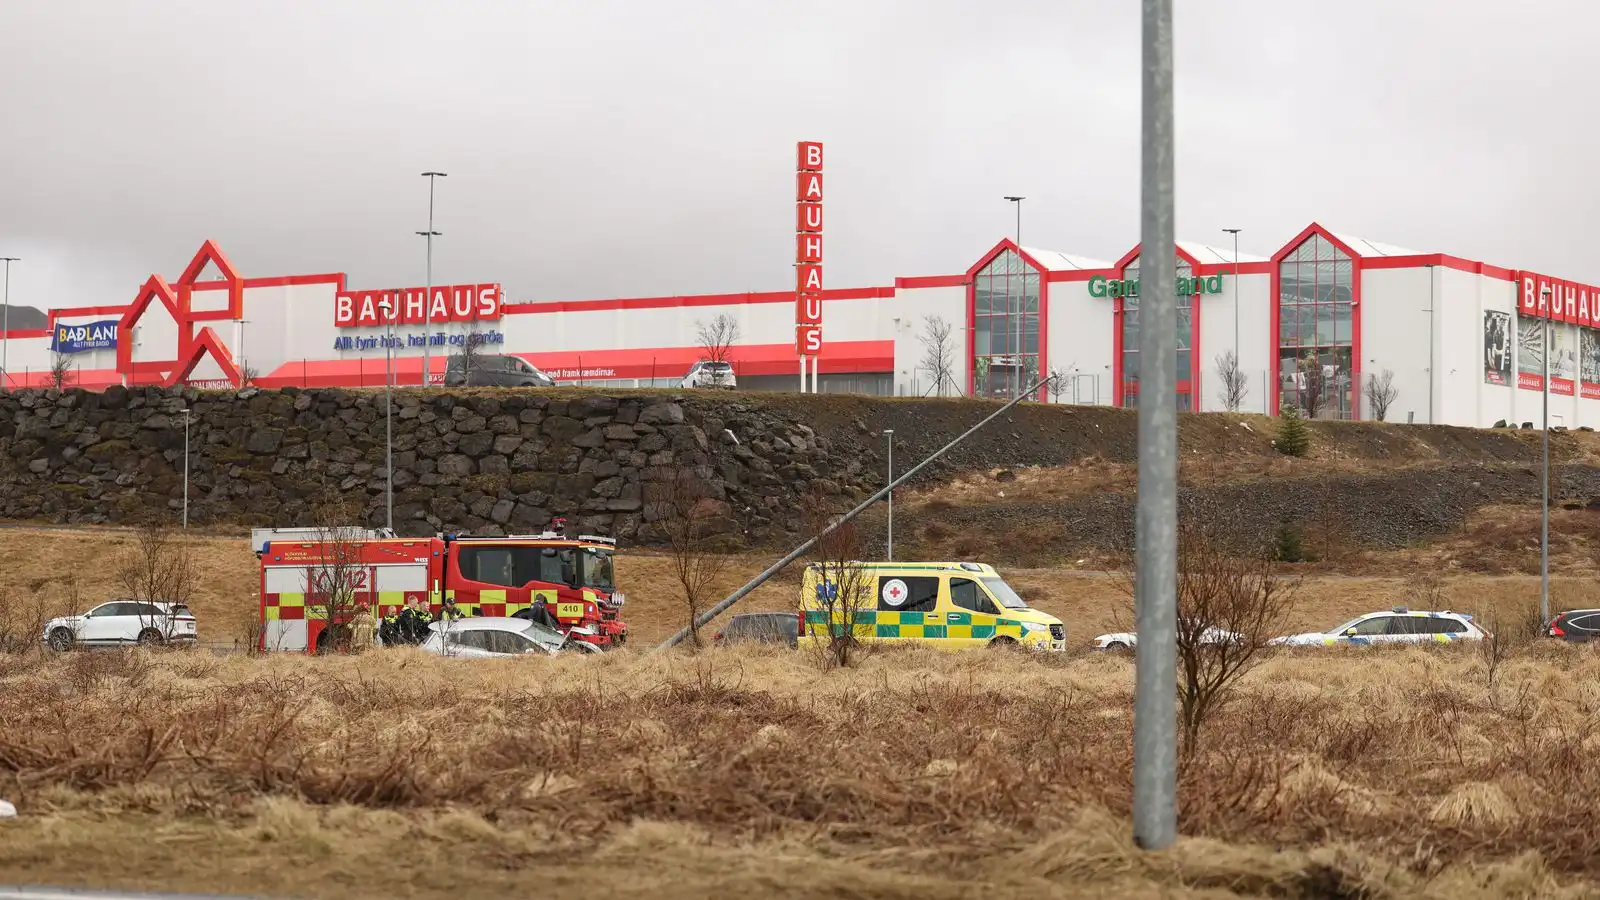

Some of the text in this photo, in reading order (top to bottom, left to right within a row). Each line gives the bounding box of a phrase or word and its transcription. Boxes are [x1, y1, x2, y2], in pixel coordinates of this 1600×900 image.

[806, 145, 821, 350] BAUHAUS
[1088, 271, 1223, 298] Garand
[337, 288, 495, 322] BAUHAUS
[334, 336, 353, 350] Allt
[355, 335, 378, 352] fyrir
[448, 334, 465, 347] og
[562, 605, 578, 613] 410
